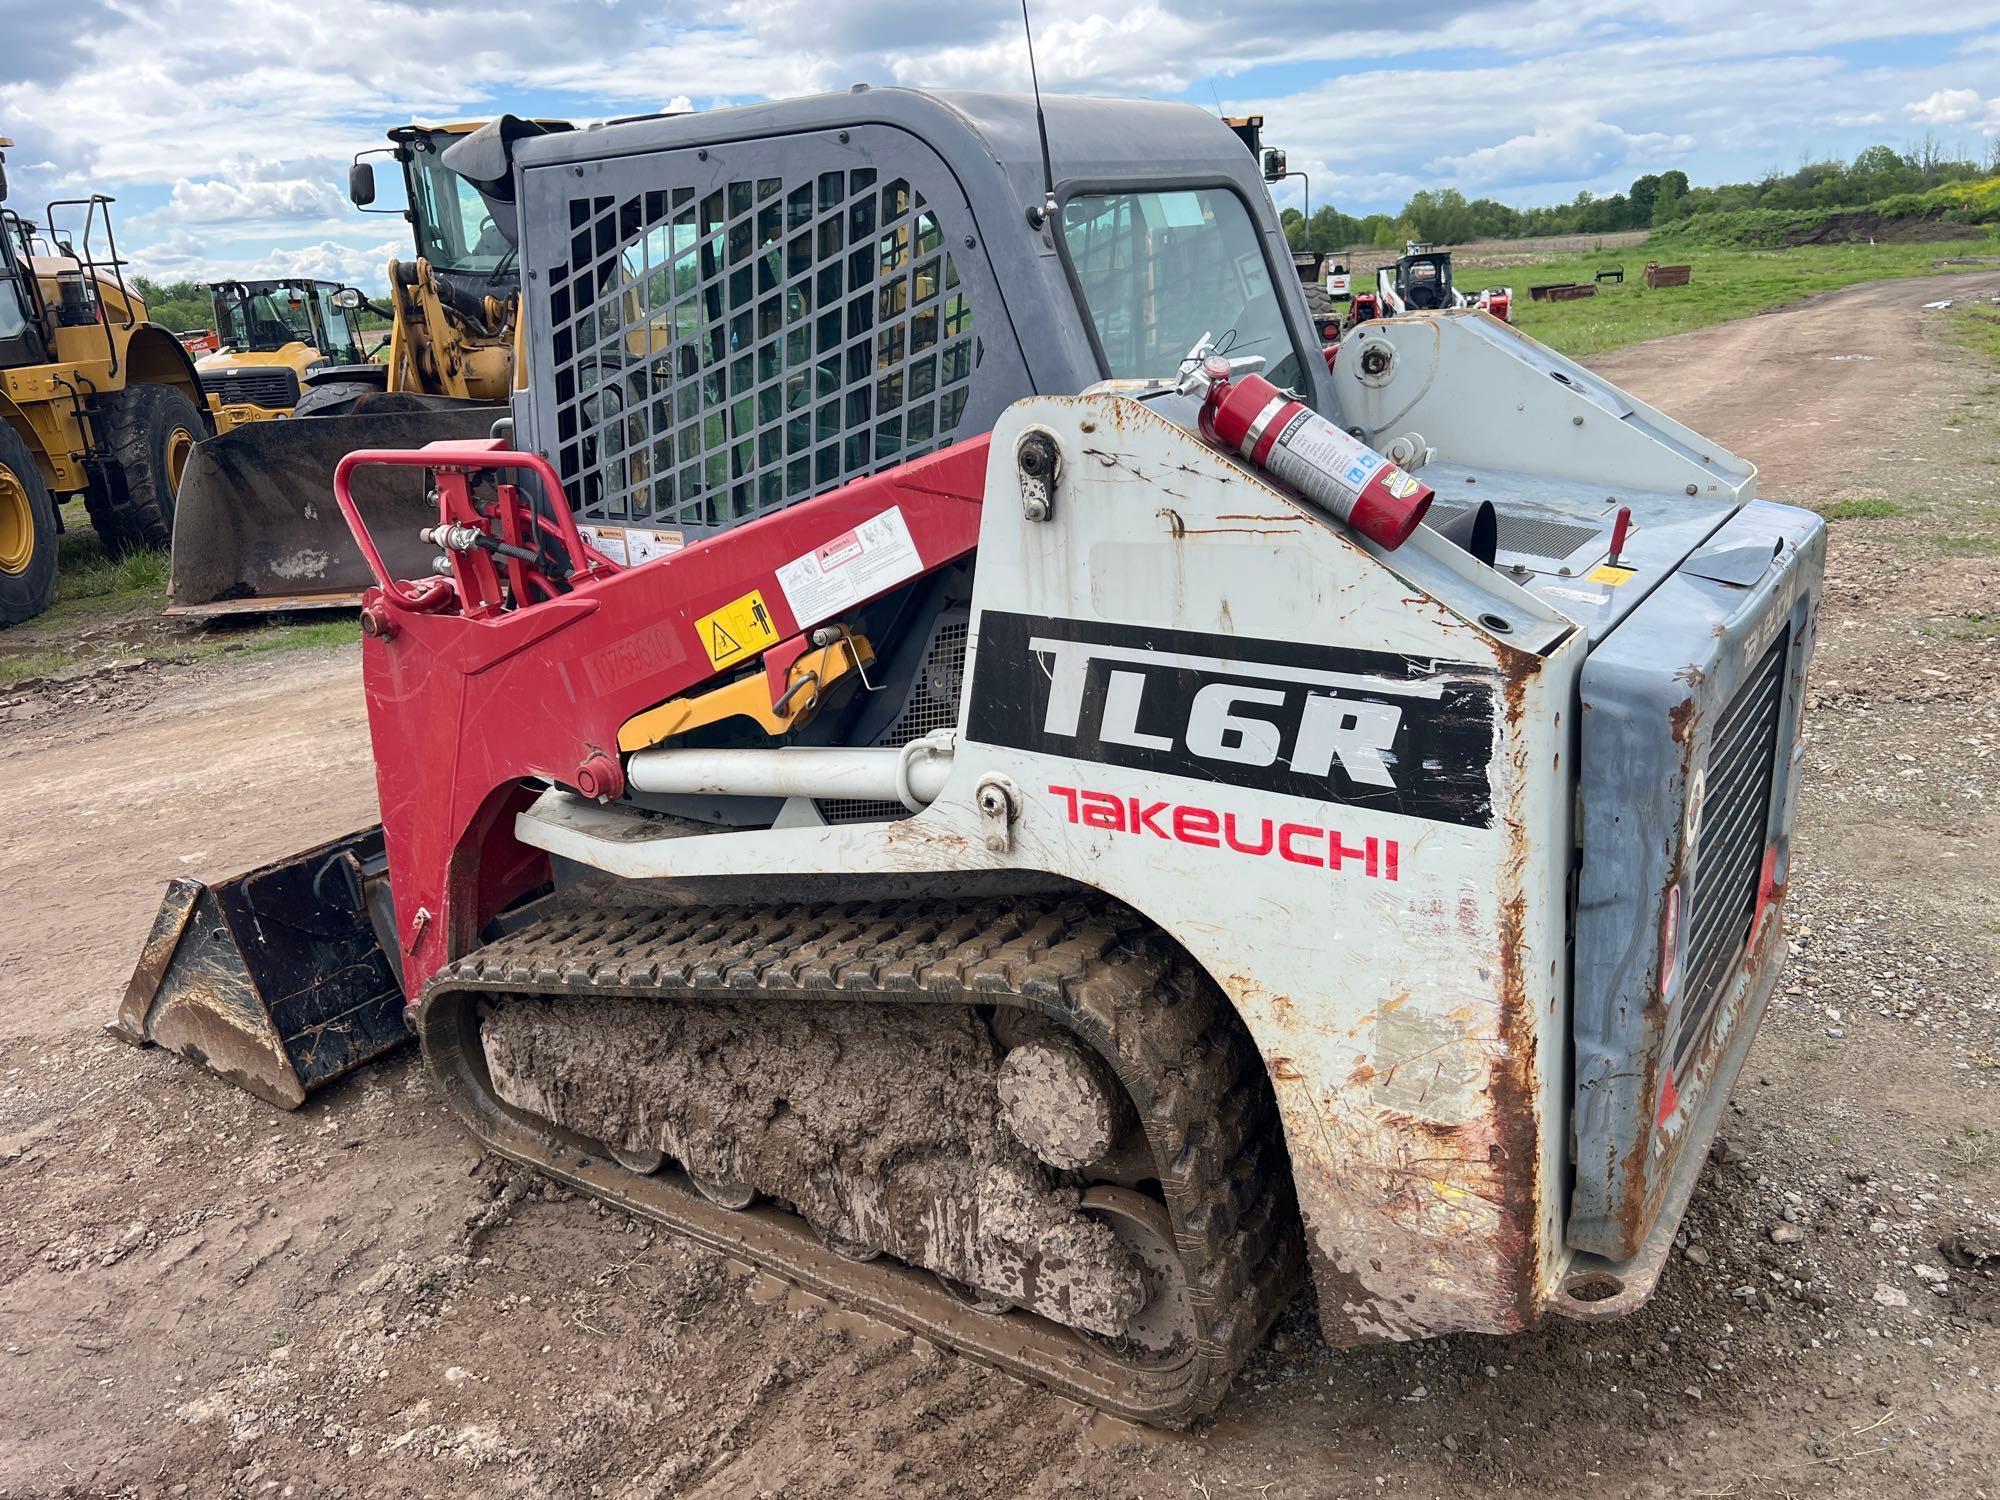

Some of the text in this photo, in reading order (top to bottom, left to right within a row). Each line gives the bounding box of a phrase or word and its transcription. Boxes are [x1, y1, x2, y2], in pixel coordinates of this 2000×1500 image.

[226, 368, 239, 376] CAT
[603, 530, 622, 538] WARNING
[828, 538, 851, 553] WARNING
[1027, 636, 1443, 789] TL6R
[1047, 784, 1399, 882] TAKEUCHI
